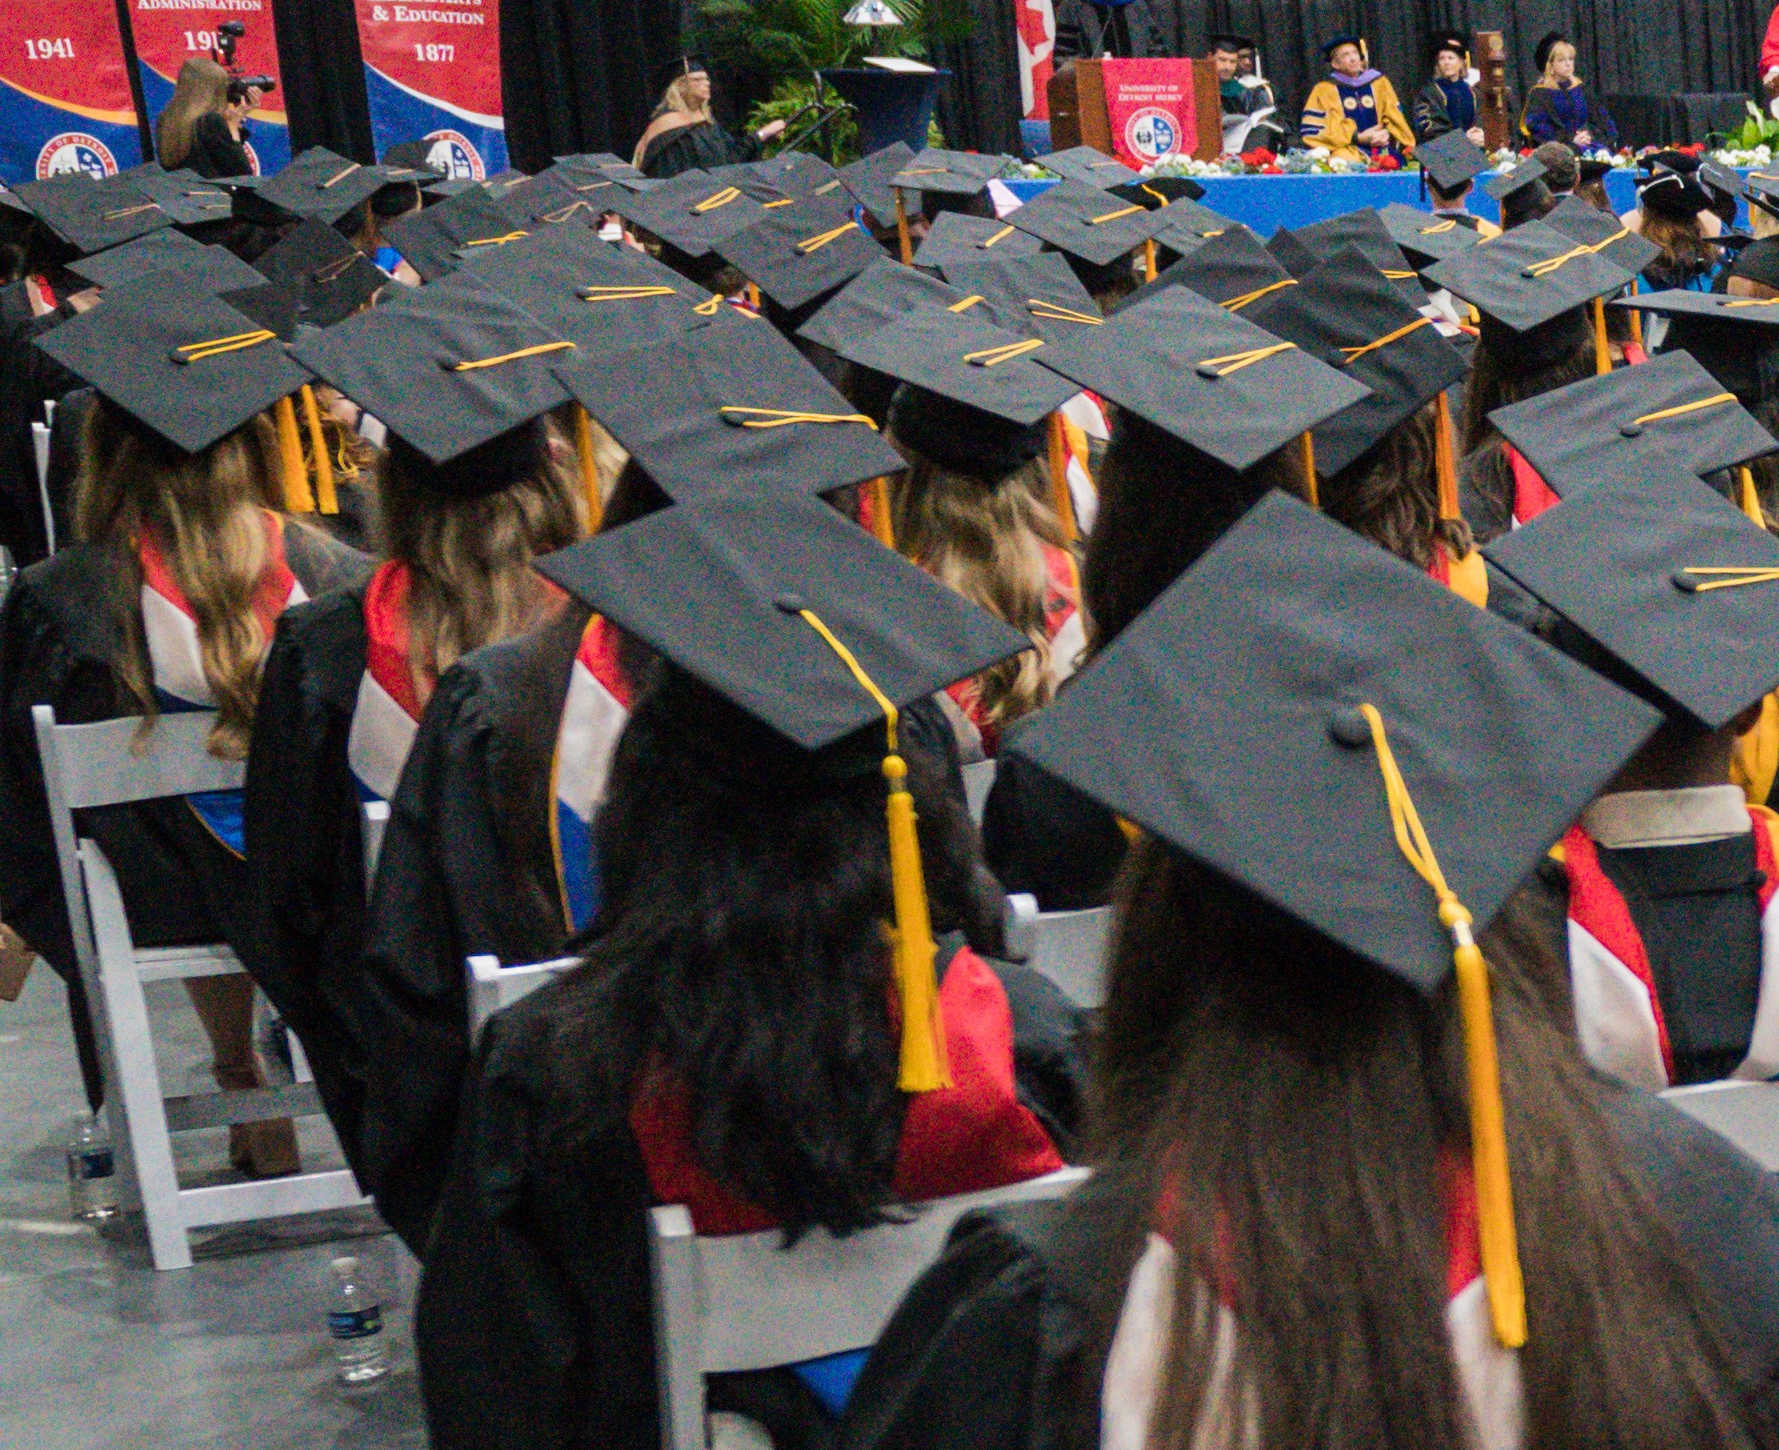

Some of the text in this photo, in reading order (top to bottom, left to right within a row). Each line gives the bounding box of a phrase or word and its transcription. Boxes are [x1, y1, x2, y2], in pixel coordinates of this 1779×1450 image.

[372, 5, 485, 25] & EDUCATION
[24, 38, 75, 60] 1941
[414, 43, 454, 63] 1877
